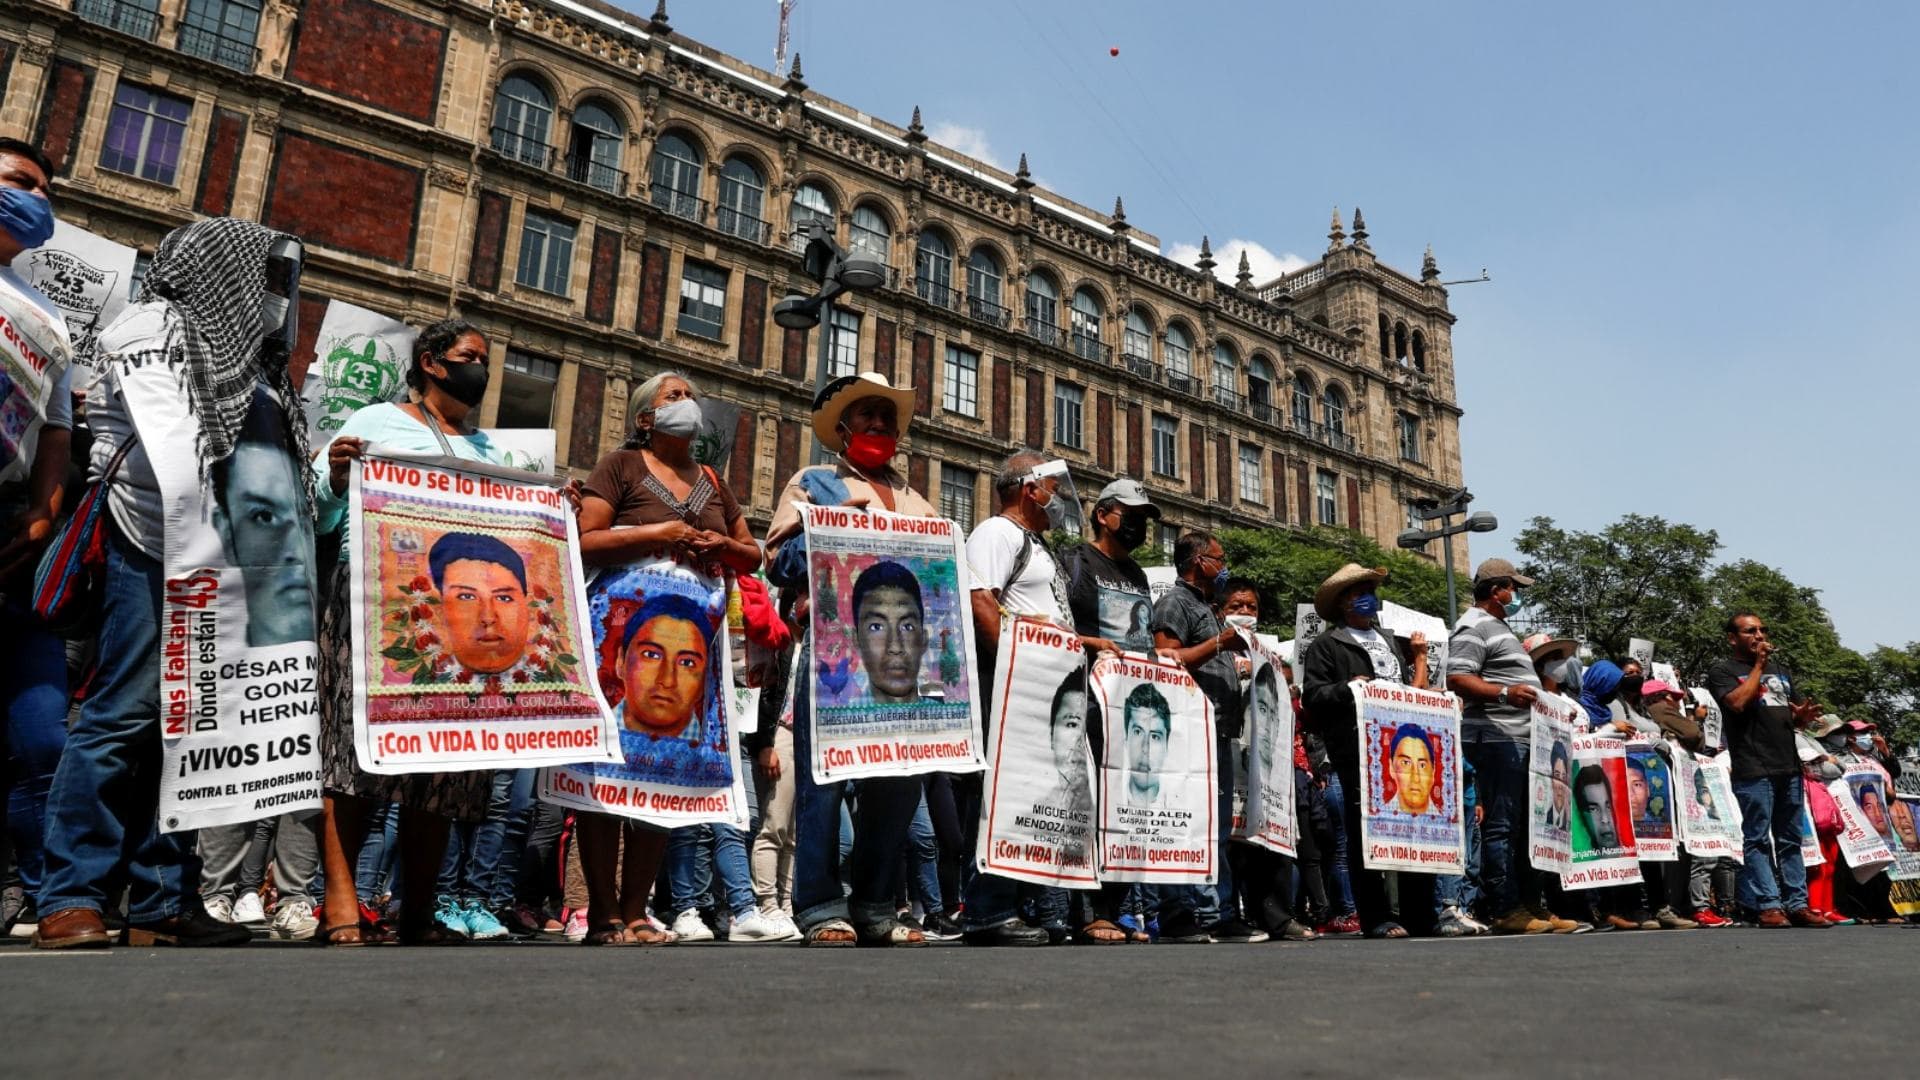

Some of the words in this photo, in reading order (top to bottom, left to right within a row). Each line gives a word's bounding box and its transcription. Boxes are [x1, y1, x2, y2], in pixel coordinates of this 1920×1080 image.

[54, 271, 85, 294] 43
[364, 460, 420, 487] ¡Vivo
[427, 473, 450, 491] se
[456, 473, 474, 495] lo
[480, 477, 562, 509] llevaron!
[809, 507, 848, 527] ¡Vivo
[852, 513, 869, 529] se
[873, 513, 887, 531] lo
[194, 611, 216, 664] están
[1019, 626, 1062, 648] ¡Vivo
[1066, 637, 1081, 653] se
[220, 657, 299, 679] CÉSAR
[1130, 666, 1141, 678] se
[1144, 665, 1153, 681] lo
[195, 670, 218, 732] Dónde
[244, 678, 316, 701] GONZ
[1391, 690, 1402, 701] se
[1404, 690, 1414, 703] lo
[377, 731, 422, 757] ¡Con
[428, 730, 477, 753] VIDA
[482, 729, 499, 750] lo
[505, 725, 599, 754] queremos!
[179, 743, 260, 777] ¡VIVOS
[266, 734, 312, 762] LOS
[824, 747, 855, 770] ¡Con
[857, 743, 893, 764] VIDA
[895, 742, 908, 761] lo
[178, 785, 222, 801] CONTRA
[225, 784, 238, 795] EL
[241, 770, 313, 793] TERRORISMO
[554, 772, 585, 796] ¡Con
[589, 782, 627, 806] VIDA
[632, 787, 647, 808] lo
[651, 792, 729, 813] queremos!
[254, 789, 319, 810] AYOTZINAPA
[1033, 803, 1068, 819] MIGUEL
[1015, 815, 1065, 833] MENDOZA
[1151, 819, 1168, 827] DE
[1172, 820, 1188, 828] LA
[1158, 811, 1192, 819] ALEN
[995, 840, 1021, 859] ¡Con
[1025, 843, 1053, 865] VIDA
[1148, 848, 1204, 864] queremos!
[1391, 846, 1408, 859] VIDA
[1410, 847, 1417, 860] lo
[1587, 868, 1608, 881] Vida
